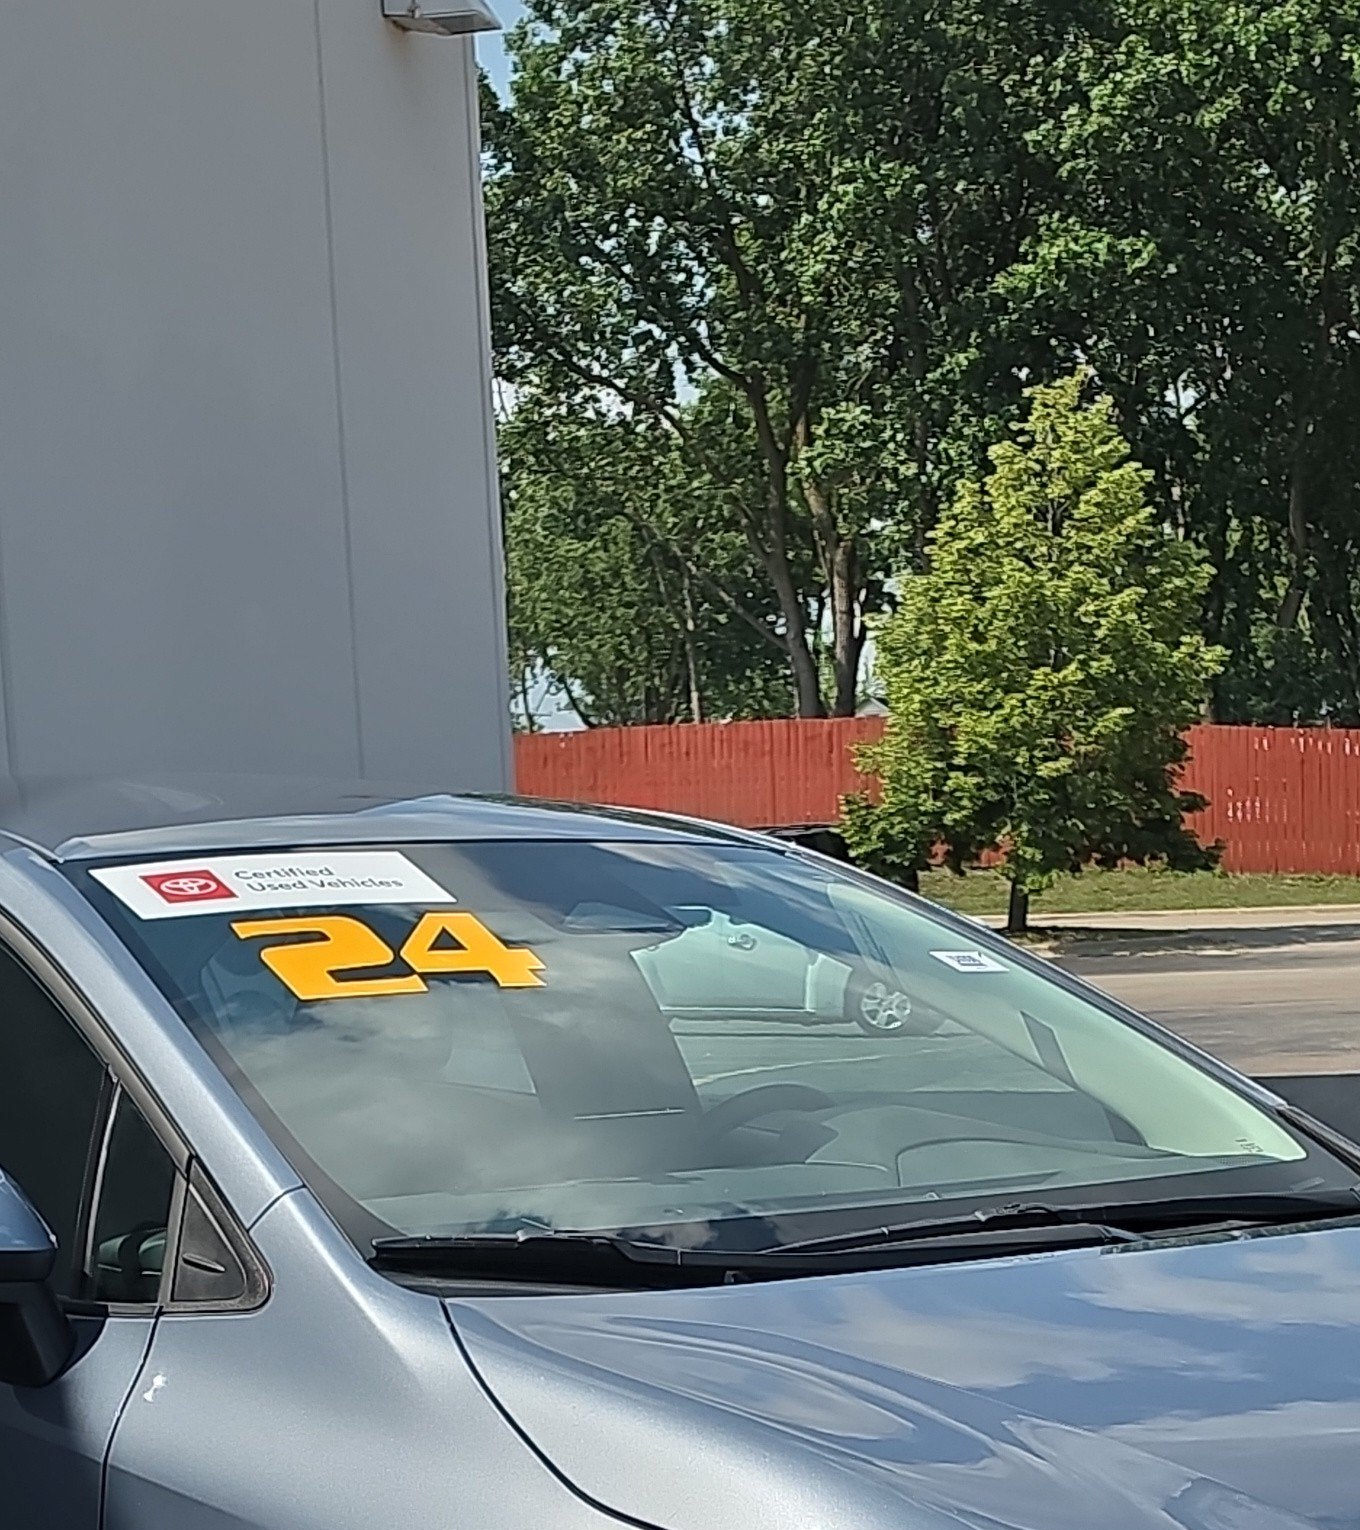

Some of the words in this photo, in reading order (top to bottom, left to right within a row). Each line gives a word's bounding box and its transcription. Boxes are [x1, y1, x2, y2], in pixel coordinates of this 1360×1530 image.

[233, 866, 336, 880] Certified
[246, 880, 308, 893] Used
[308, 877, 404, 889] Vehicles
[229, 911, 548, 1001] 24
